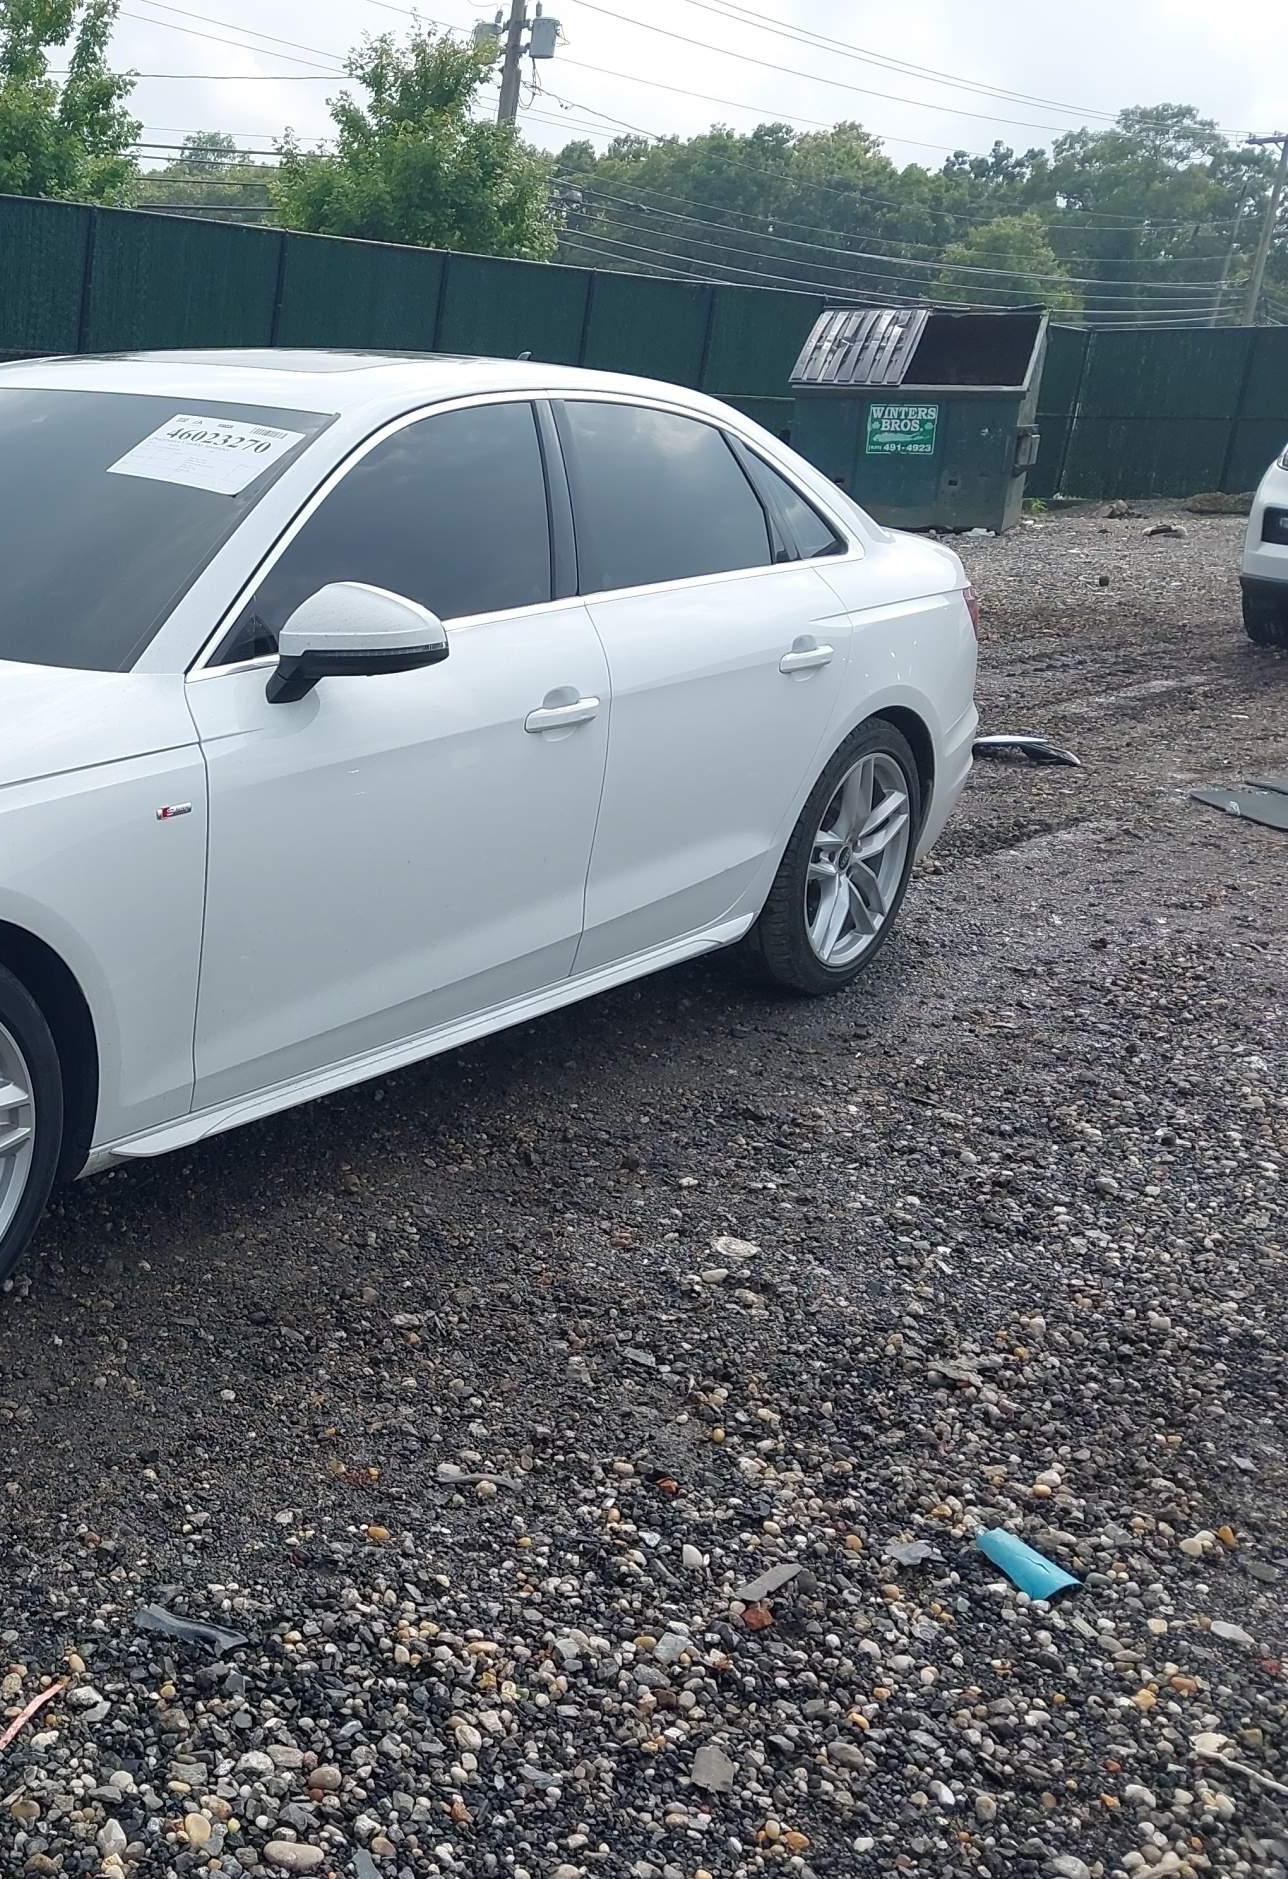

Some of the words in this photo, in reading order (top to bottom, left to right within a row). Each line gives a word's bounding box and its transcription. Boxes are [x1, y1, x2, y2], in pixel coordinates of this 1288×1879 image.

[872, 407, 936, 419] WINTERS
[880, 419, 923, 431] BROS.
[166, 427, 272, 454] 46023270
[883, 443, 931, 452] 491-4923
